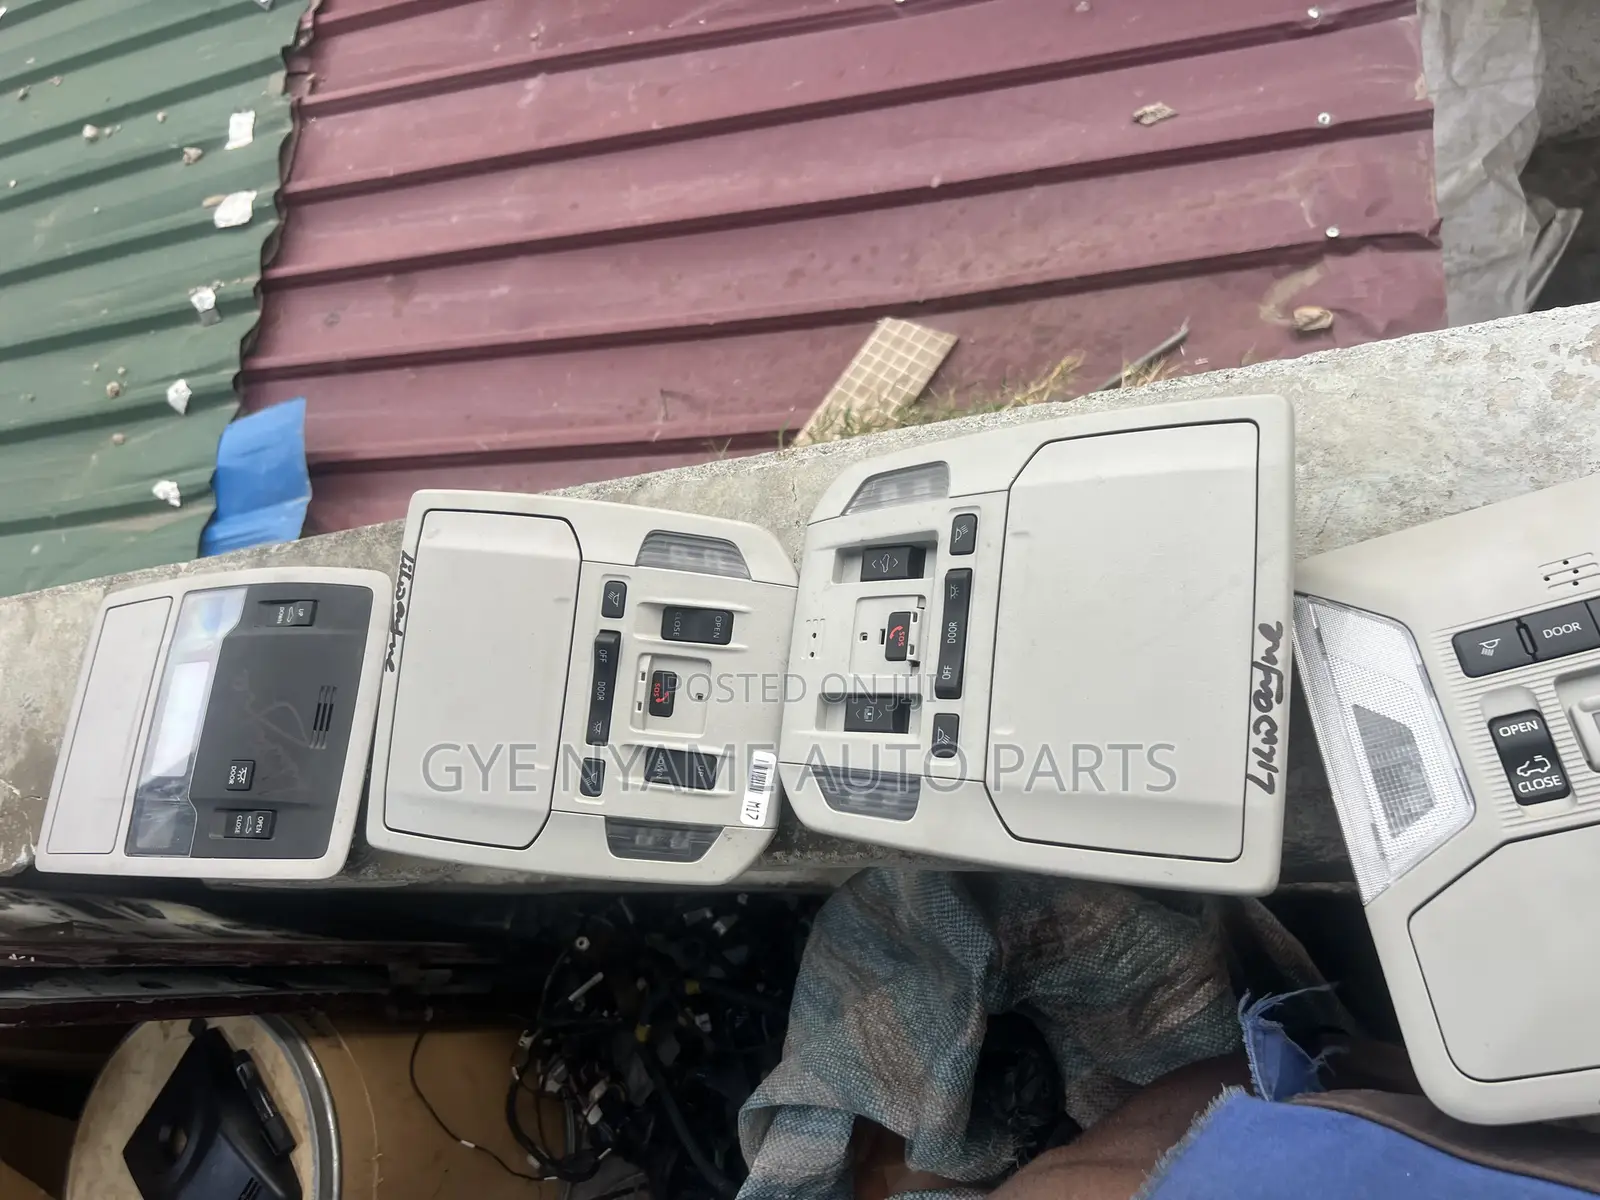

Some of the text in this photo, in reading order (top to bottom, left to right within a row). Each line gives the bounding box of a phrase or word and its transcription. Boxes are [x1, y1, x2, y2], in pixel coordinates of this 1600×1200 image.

[672, 611, 682, 637] CLOSE
[713, 615, 722, 639] OPEN
[947, 621, 957, 644] DOOR
[1542, 621, 1582, 639] DOOR
[599, 649, 607, 663] OFF
[941, 665, 952, 680] OFF
[596, 681, 606, 701] DOOR
[653, 683, 661, 697] SOS
[1499, 720, 1539, 738] OPEN
[228, 766, 237, 785] DOOR
[1518, 775, 1562, 794] CLOSE
[234, 815, 243, 834] CLOSE
[255, 816, 264, 834] OPEN
